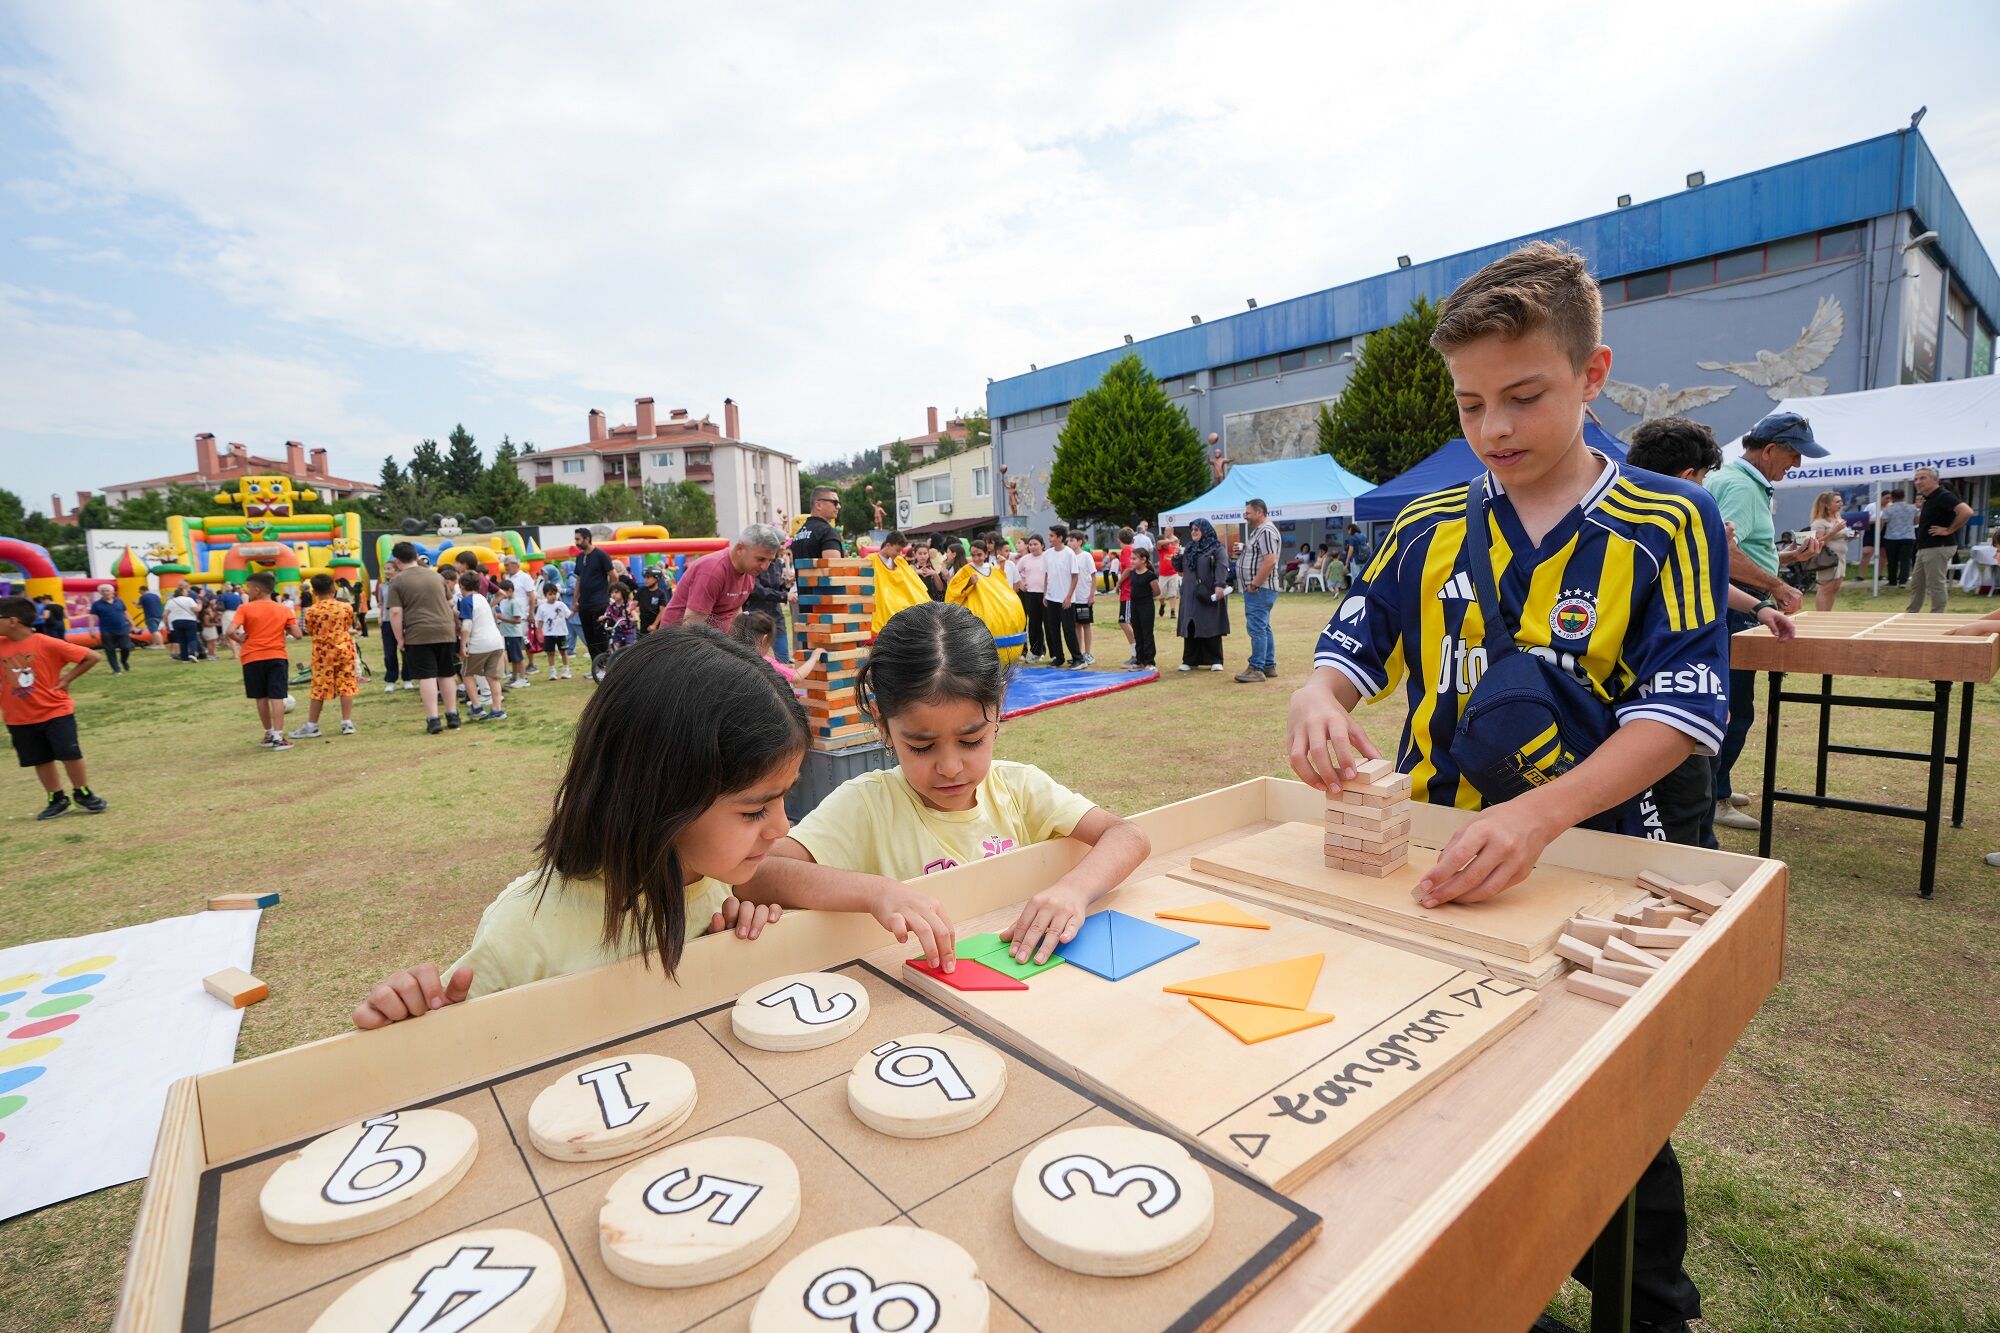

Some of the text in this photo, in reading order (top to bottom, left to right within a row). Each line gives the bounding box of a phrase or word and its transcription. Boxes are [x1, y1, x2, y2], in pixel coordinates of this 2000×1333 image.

[1787, 465, 1864, 480] GAZİEMİR
[1211, 512, 1242, 520] GAZİEMİR
[1574, 599, 1592, 610] SPOR
[1639, 788, 1667, 842] SAF
[756, 981, 857, 1026] 2
[577, 1061, 651, 1130] 1
[1267, 1008, 1465, 1125] tangram
[642, 1167, 764, 1226] 5
[1039, 1154, 1182, 1218] 3
[388, 1246, 537, 1333] 4
[802, 1266, 941, 1333] 8
